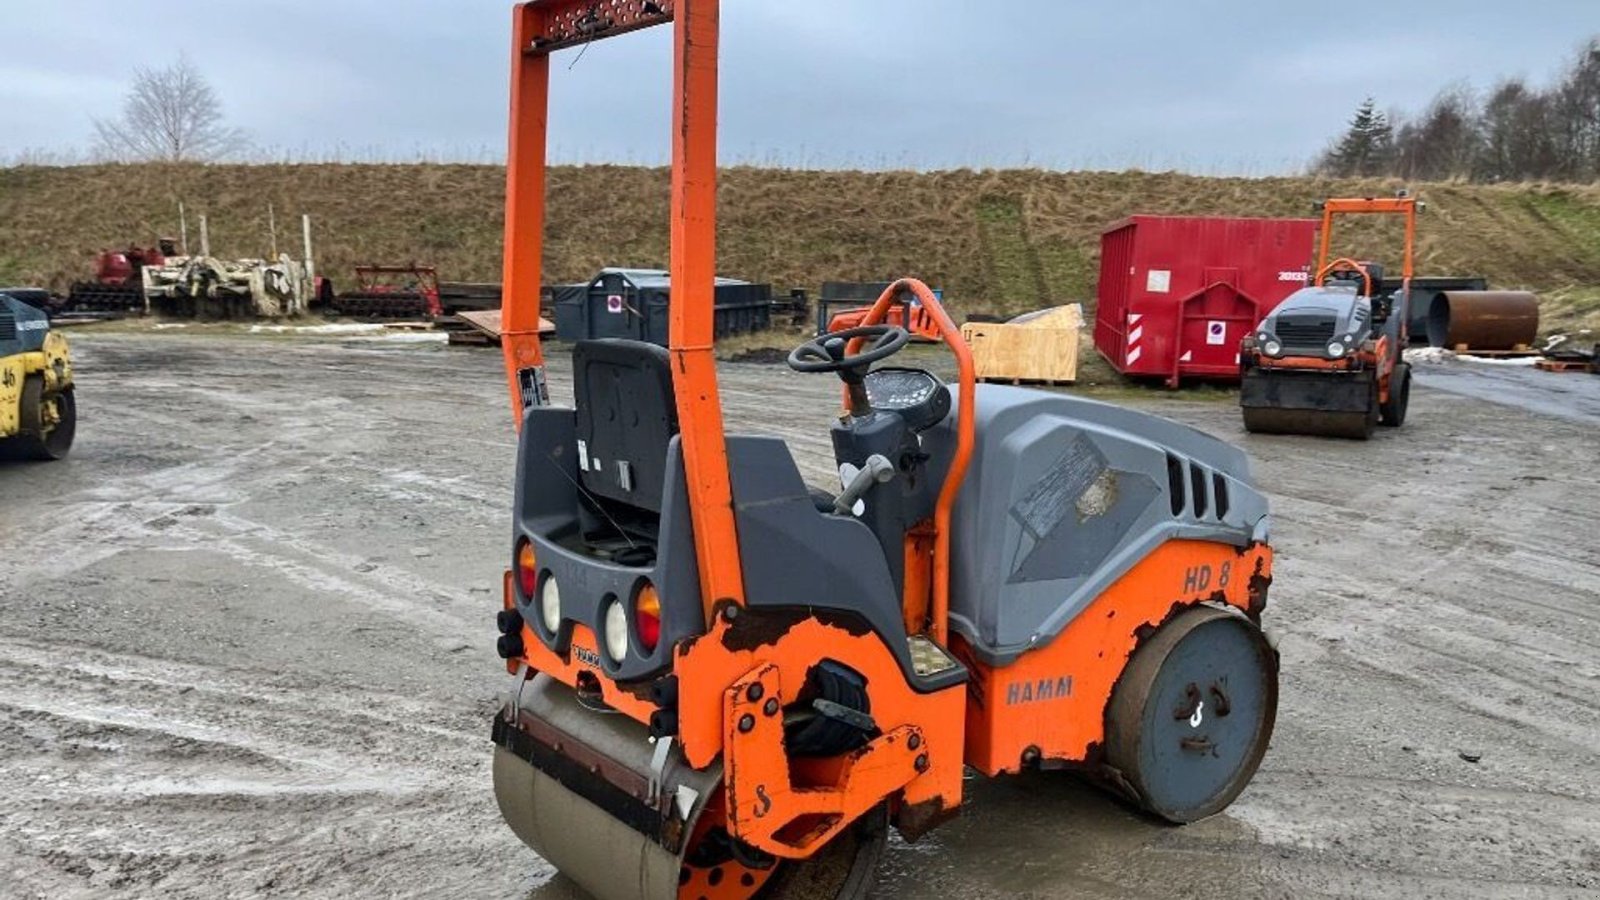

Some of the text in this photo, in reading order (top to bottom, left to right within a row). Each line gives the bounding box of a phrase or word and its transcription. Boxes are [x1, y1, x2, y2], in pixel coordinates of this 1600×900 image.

[3, 366, 16, 388] 46
[1183, 560, 1230, 594] HD 8
[1006, 675, 1073, 705] HAMM
